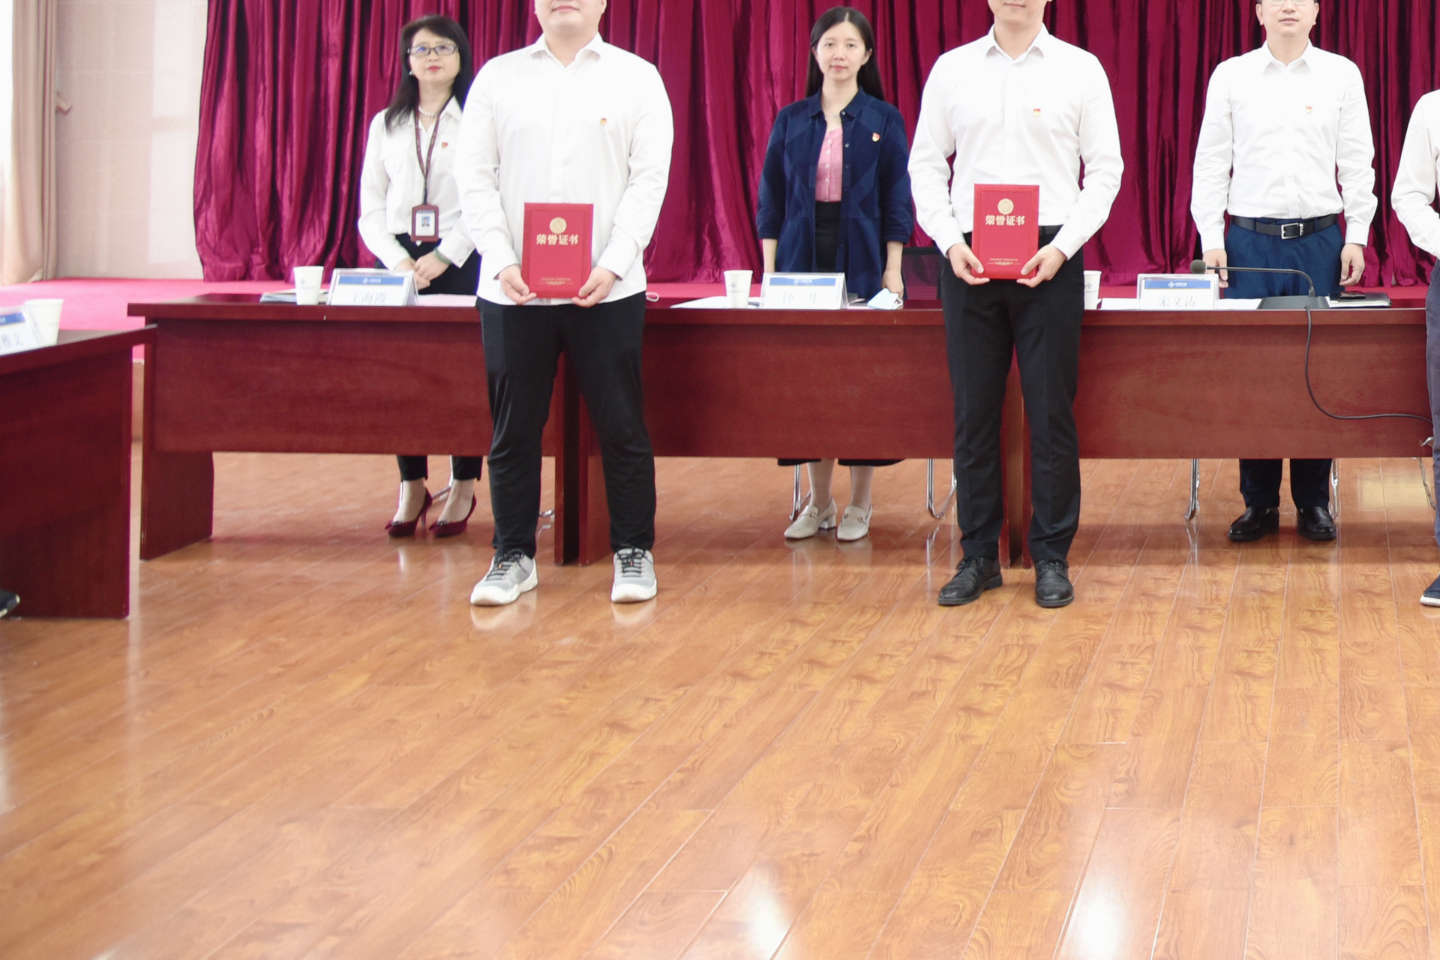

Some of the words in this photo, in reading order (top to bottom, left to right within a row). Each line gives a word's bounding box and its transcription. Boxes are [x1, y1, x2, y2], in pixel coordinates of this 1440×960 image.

[984, 214, 1026, 227] 荣誉证书
[536, 233, 579, 246] 荣誉证书
